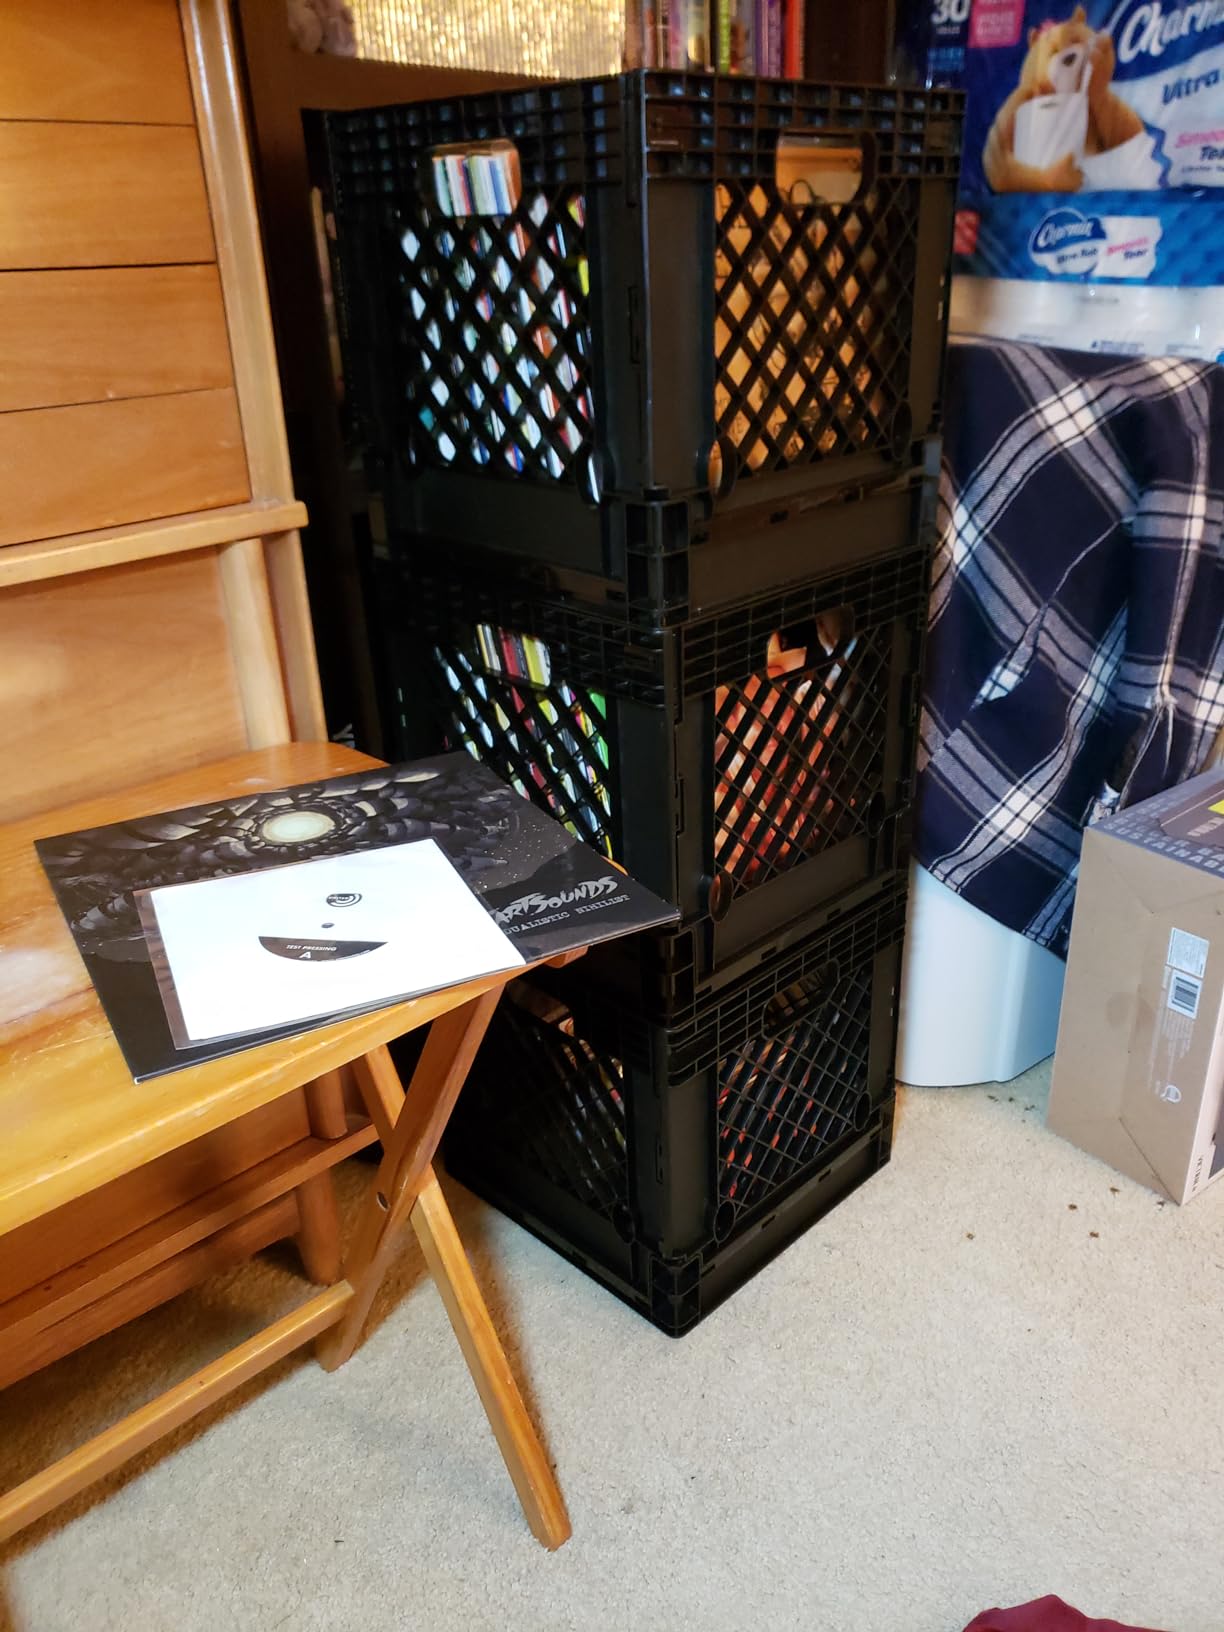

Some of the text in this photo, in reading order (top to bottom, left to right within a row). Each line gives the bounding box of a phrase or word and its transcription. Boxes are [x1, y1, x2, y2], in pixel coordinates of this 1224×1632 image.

[1161, 69, 1220, 105] Ultra
[503, 894, 631, 935] DUALISTIC NIHILIST
[299, 951, 312, 959] A
